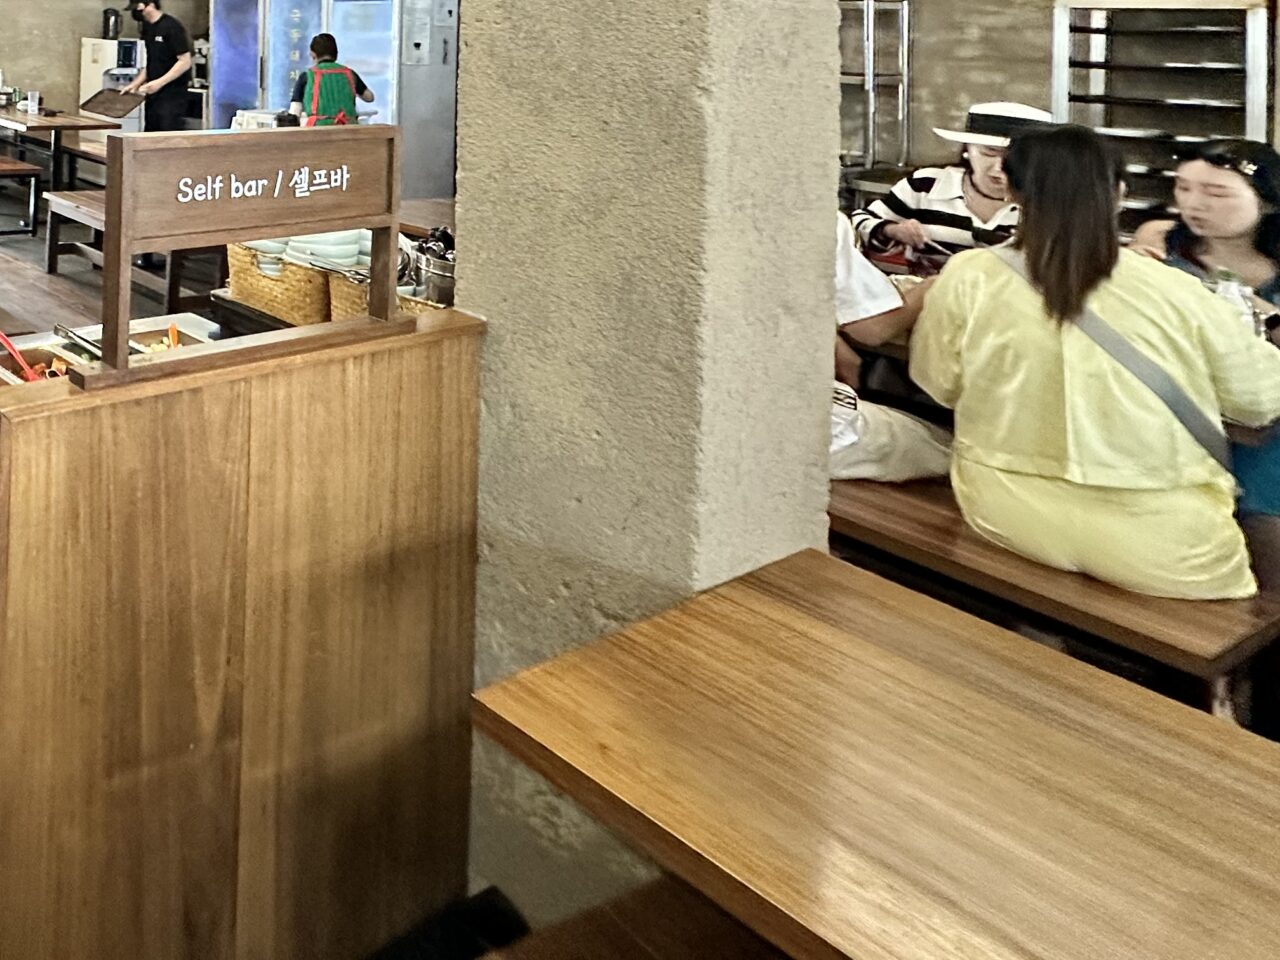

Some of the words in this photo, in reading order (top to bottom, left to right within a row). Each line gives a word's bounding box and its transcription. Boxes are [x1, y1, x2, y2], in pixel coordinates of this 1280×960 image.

[177, 175, 224, 203] Self
[230, 174, 269, 199] bar
[288, 165, 351, 198] 셀프바
